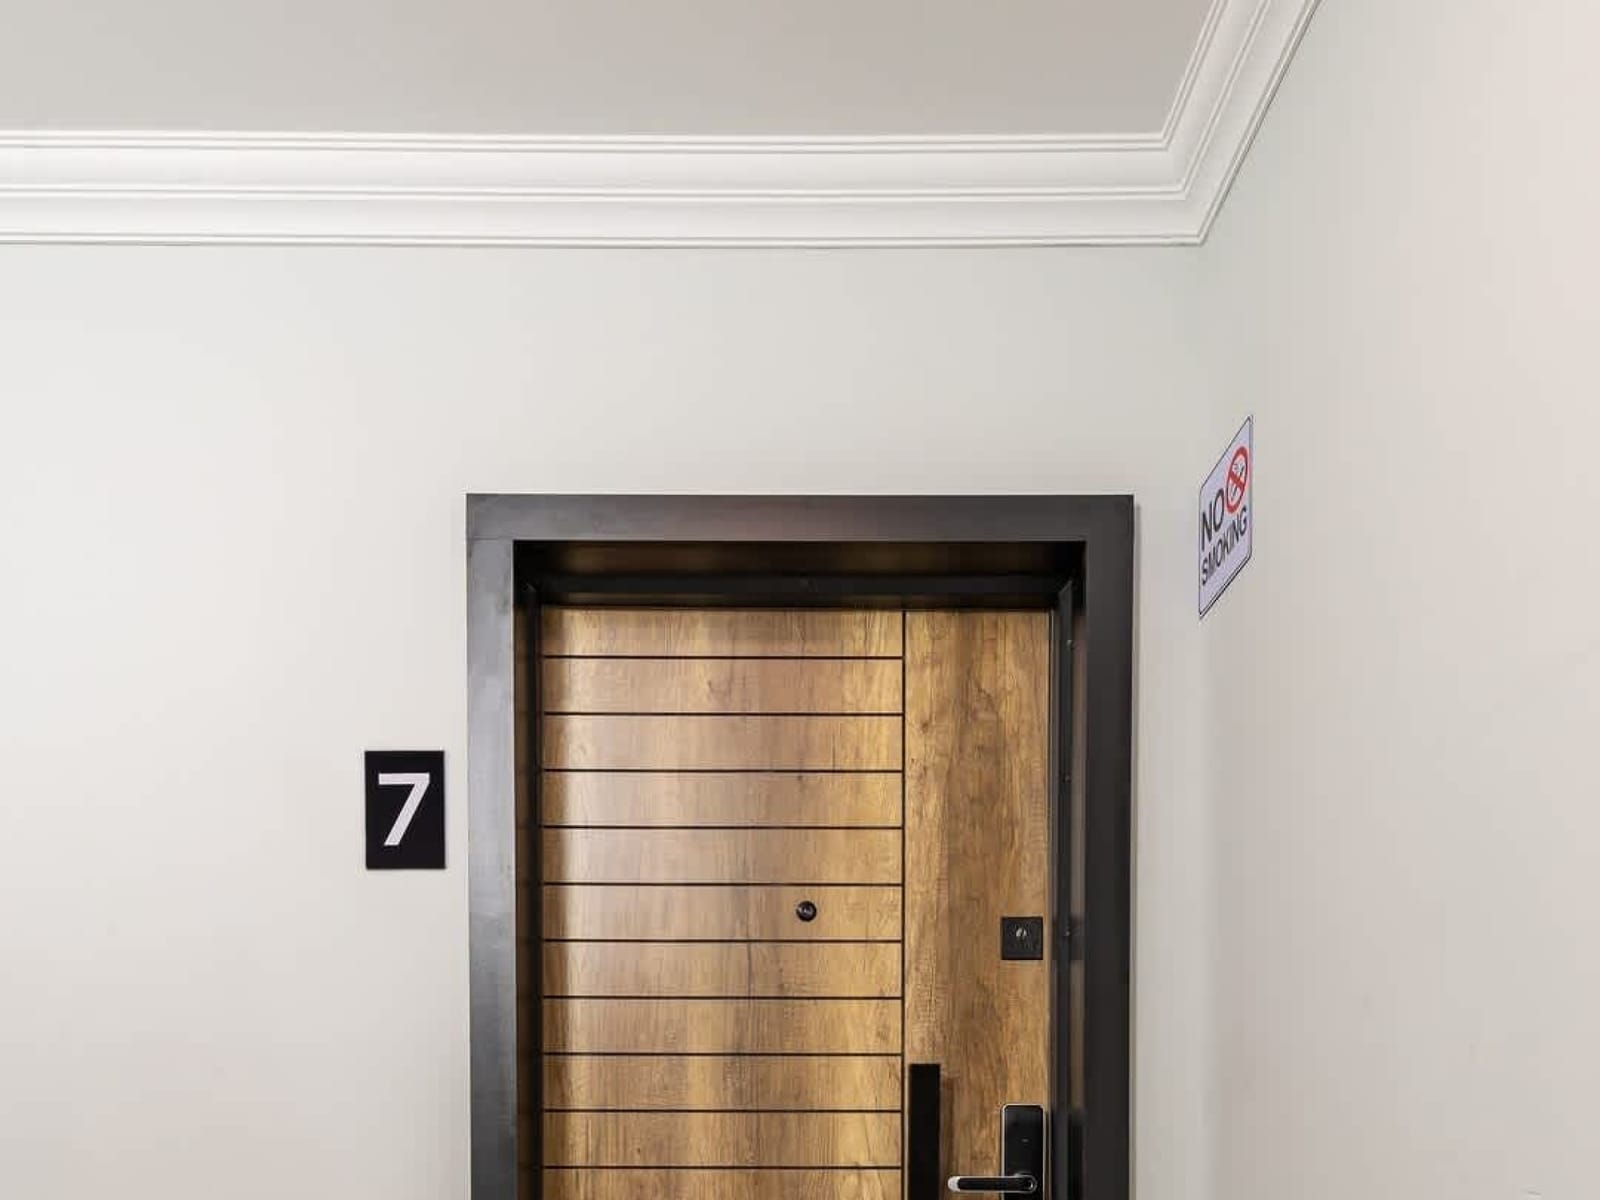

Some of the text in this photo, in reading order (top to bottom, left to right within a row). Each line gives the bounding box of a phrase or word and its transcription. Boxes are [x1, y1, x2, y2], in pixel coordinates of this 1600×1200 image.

[1202, 487, 1225, 551] NO
[1202, 506, 1247, 586] SMOKING
[378, 772, 430, 846] 7
